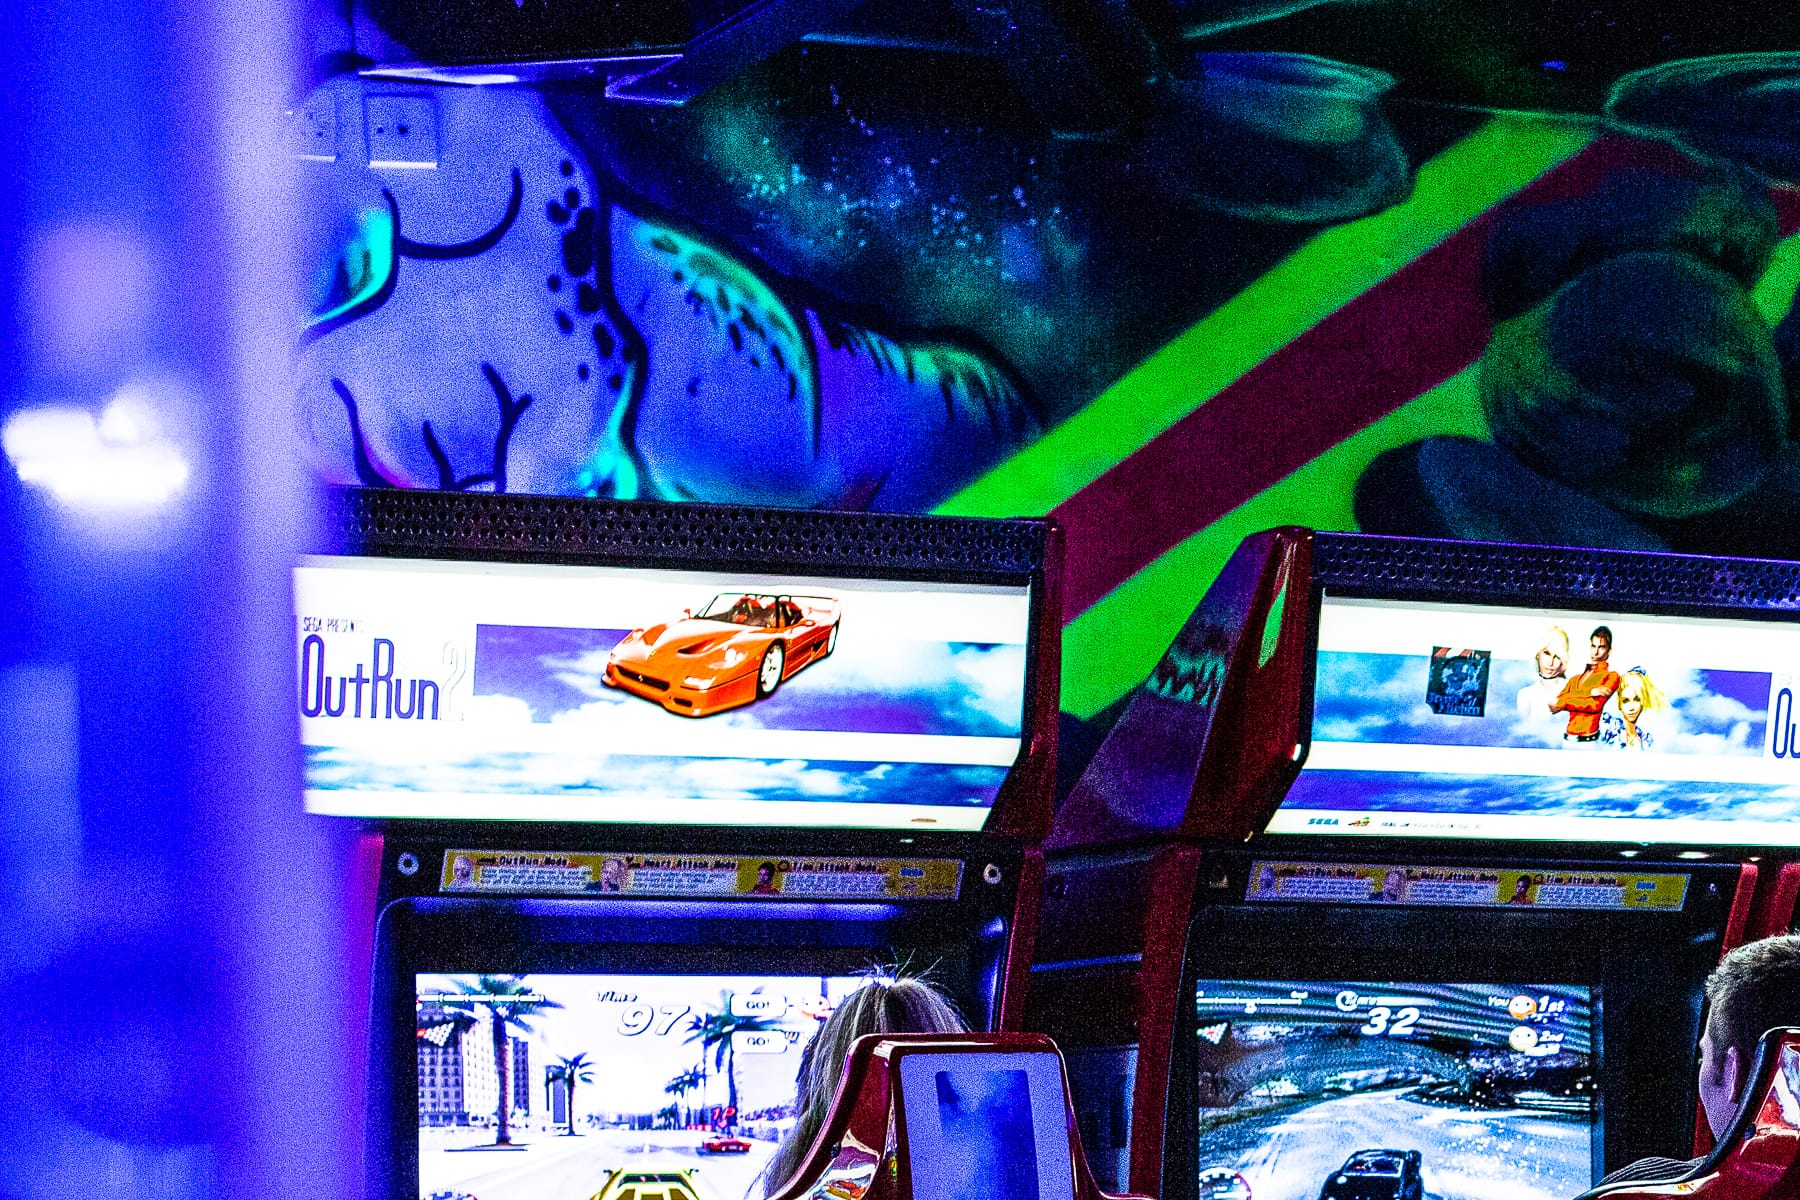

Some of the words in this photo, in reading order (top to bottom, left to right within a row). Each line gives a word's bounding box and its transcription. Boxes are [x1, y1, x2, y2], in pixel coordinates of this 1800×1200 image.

[303, 616, 322, 633] SEGA
[1308, 817, 1339, 826] SEGA
[746, 1001, 770, 1010] GO!
[616, 1004, 691, 1037] 97
[1360, 1007, 1420, 1036] 32
